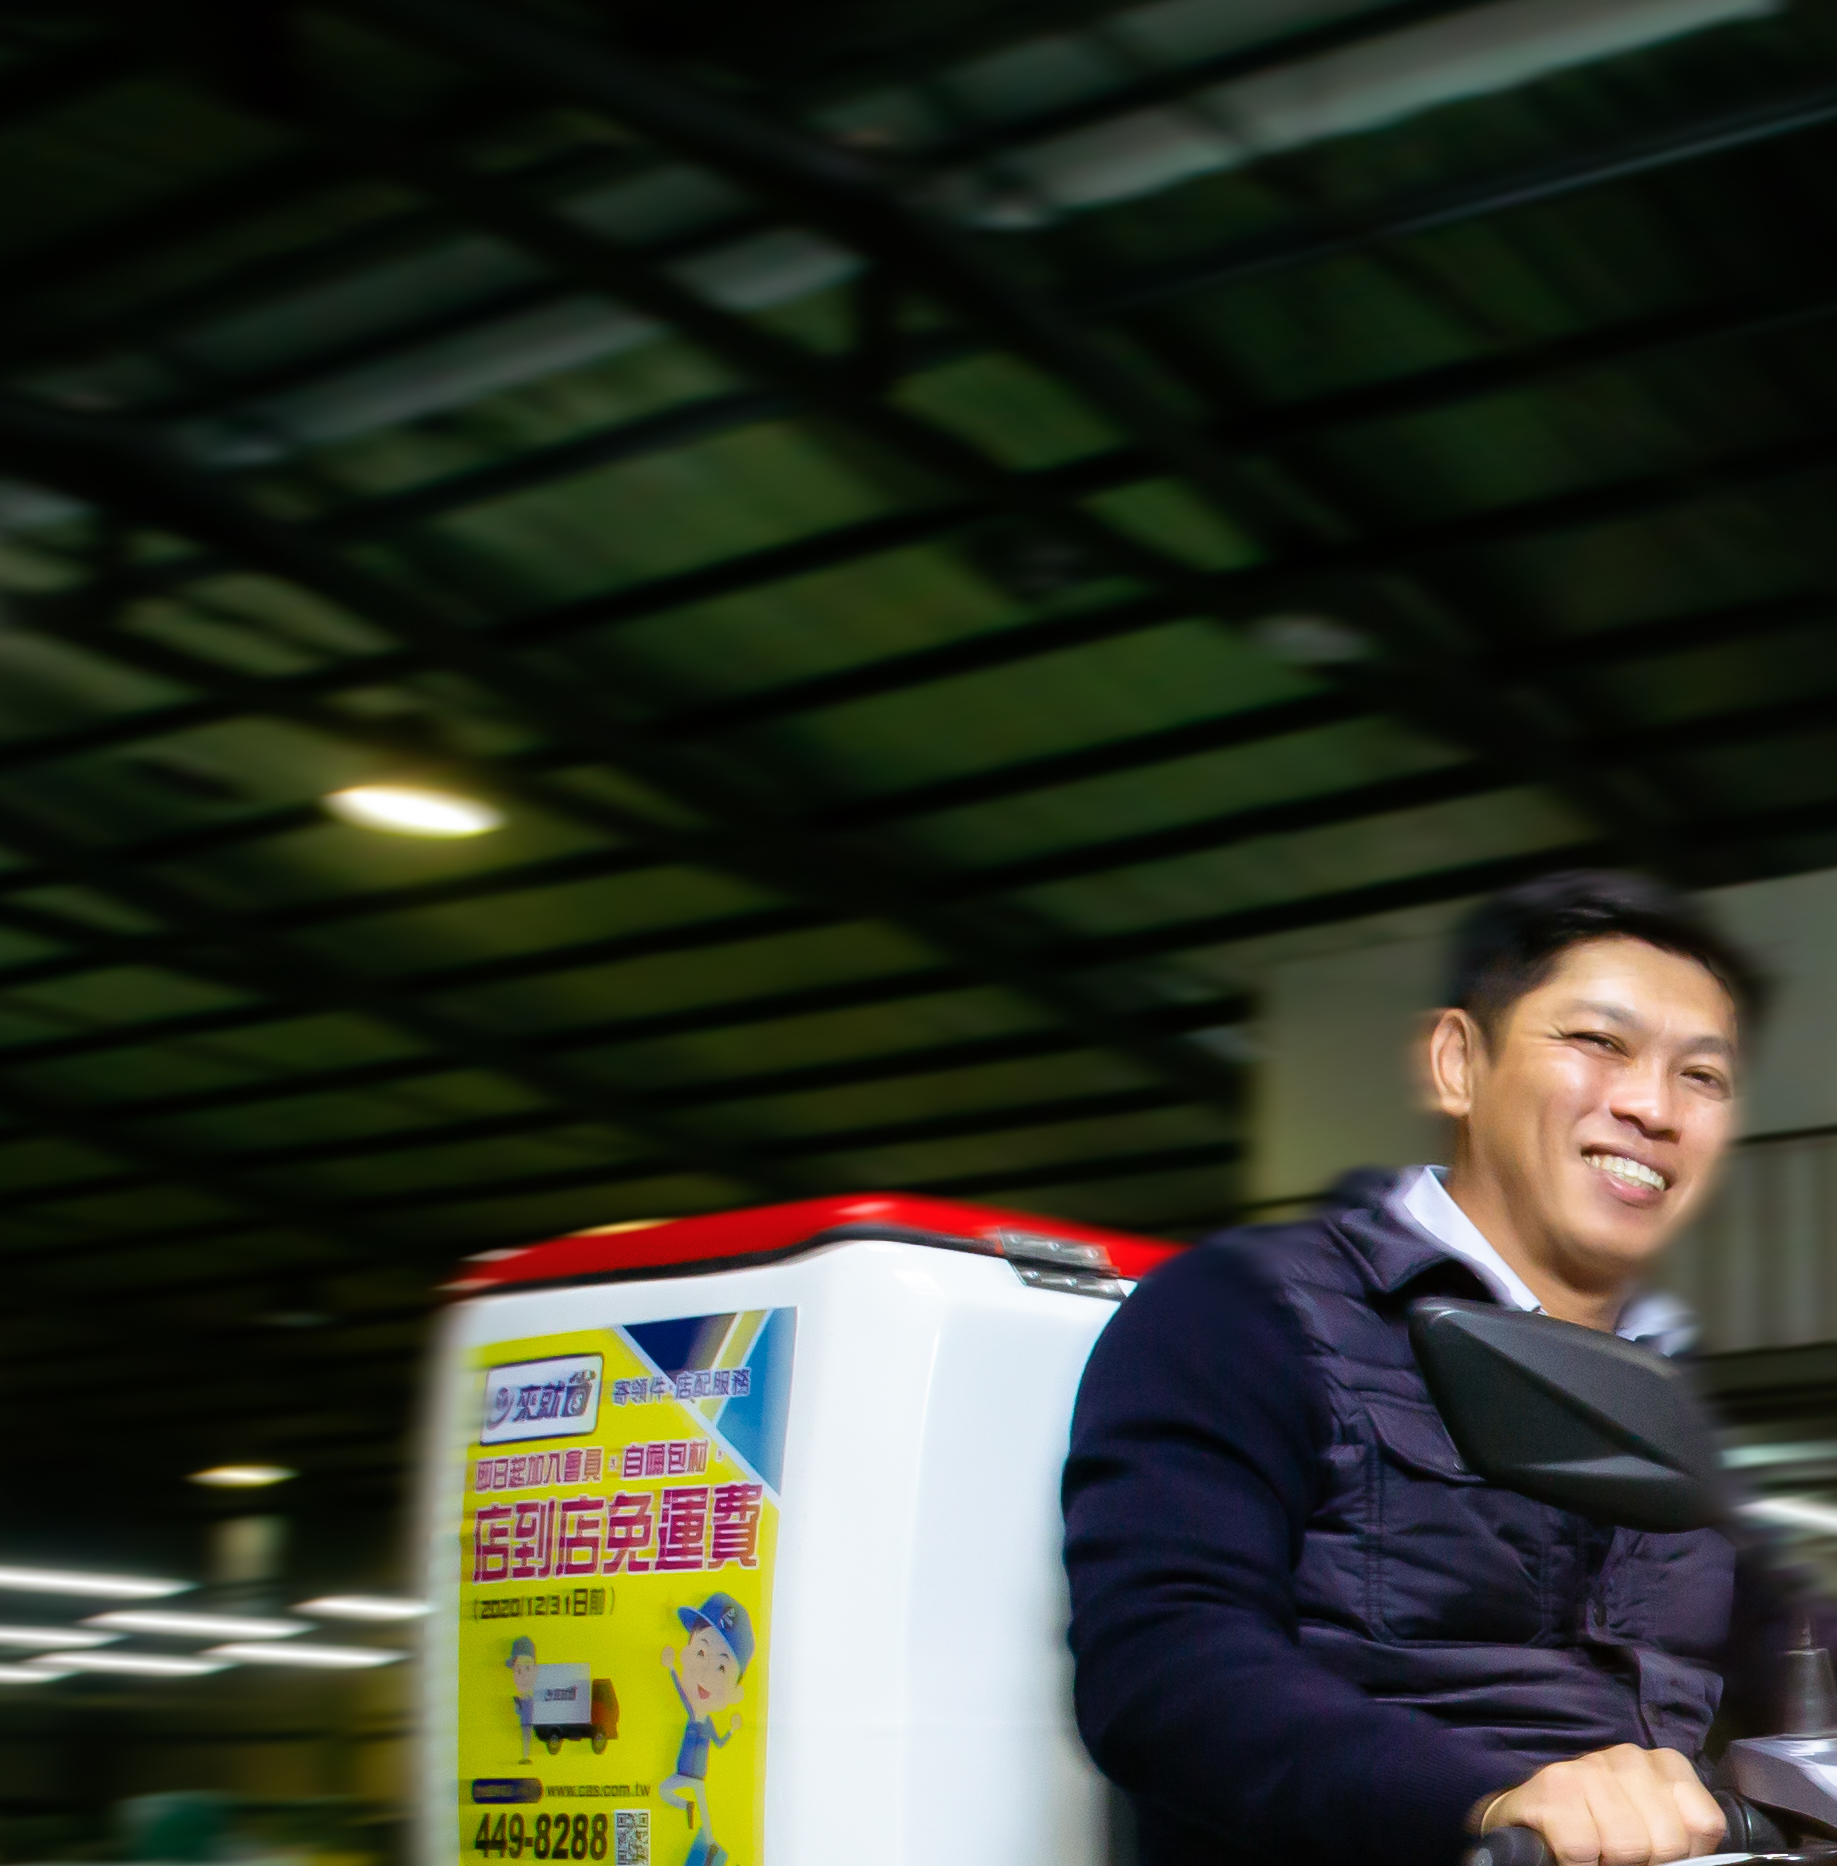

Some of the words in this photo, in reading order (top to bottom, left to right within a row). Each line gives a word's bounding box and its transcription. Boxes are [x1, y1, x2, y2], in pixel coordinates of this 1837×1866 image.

[473, 1484, 762, 1584] 店到店免運費
[475, 1812, 608, 1860] 449-8288
